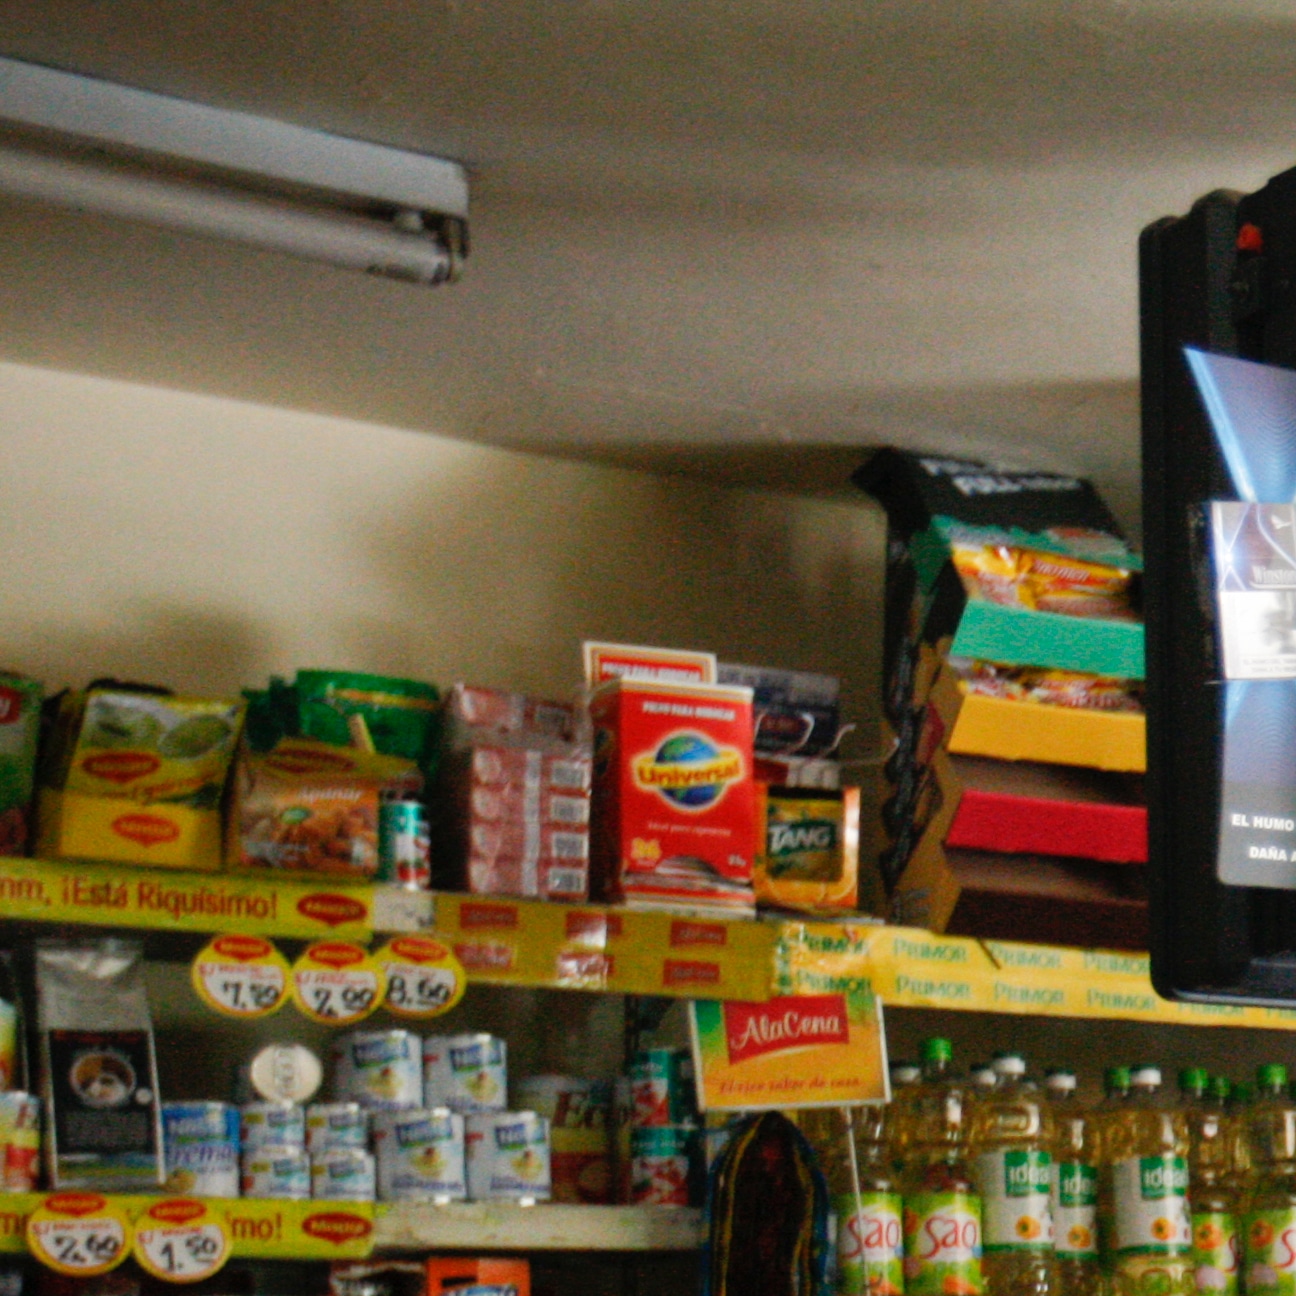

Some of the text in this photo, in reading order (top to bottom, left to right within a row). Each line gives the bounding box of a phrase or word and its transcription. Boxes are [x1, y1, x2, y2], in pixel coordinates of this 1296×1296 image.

[637, 754, 745, 788] Universal
[769, 823, 832, 851] TANG
[1232, 813, 1248, 828] EL
[1253, 816, 1295, 833] HUMO
[1249, 844, 1288, 861] DAÑA
[62, 877, 128, 909] ¡Está
[137, 880, 279, 921] Riquísimo!
[894, 937, 968, 964] PRIMOR
[895, 976, 970, 1000] PRIMOR
[994, 982, 1066, 1007] PRIMOR
[1088, 988, 1156, 1012] PRIMOR
[922, 1214, 977, 1260] Sao
